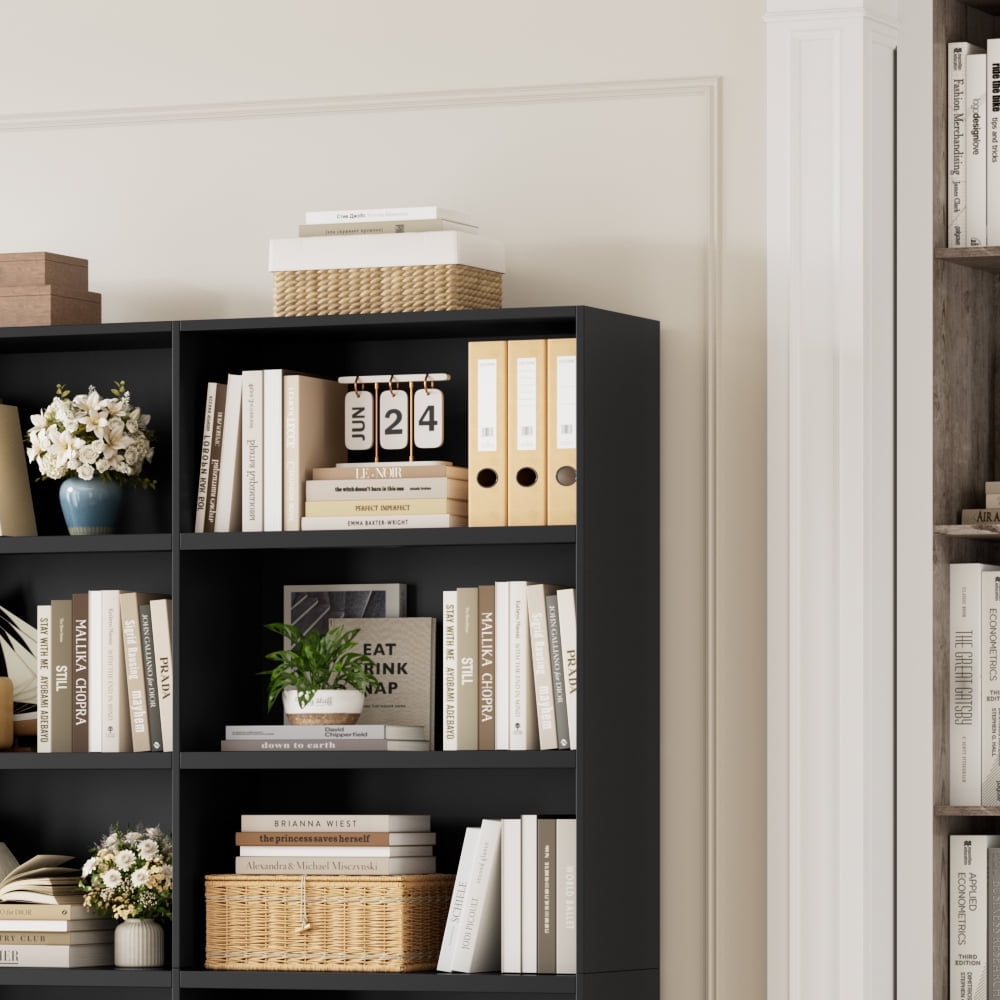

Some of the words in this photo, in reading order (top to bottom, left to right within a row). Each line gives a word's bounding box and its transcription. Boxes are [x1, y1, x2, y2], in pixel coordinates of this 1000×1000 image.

[992, 63, 1000, 78] ride
[954, 79, 964, 110] Fashion
[992, 81, 1000, 93] the
[992, 95, 1000, 112] bike
[990, 118, 998, 129] tips
[951, 114, 964, 175] Merchandising
[952, 181, 960, 196] James
[953, 198, 961, 212] Clark
[352, 406, 365, 440] JUN
[384, 409, 403, 434] 2
[418, 406, 438, 431] 4
[356, 467, 369, 478] LE
[977, 511, 992, 521] AIR
[142, 614, 150, 635] JOHN
[532, 613, 544, 638] Sigrid
[549, 606, 557, 628] JOHN
[75, 620, 86, 672] MALLIKA
[124, 620, 137, 644] Sigrid
[481, 612, 492, 666] MALLIKA
[955, 630, 973, 649] THE
[989, 608, 998, 681] ECONOMETRICS
[40, 638, 48, 656] WITH
[145, 637, 153, 676] GALLIANO
[364, 643, 396, 656] EAT
[447, 649, 454, 660] ME
[550, 629, 560, 670] GALLIANO
[40, 659, 48, 669] ME
[56, 665, 68, 692] STILL
[128, 648, 139, 680] Rausing
[159, 657, 171, 700] PRADA
[461, 657, 473, 685] STILL
[567, 650, 576, 694] PRADA
[955, 651, 973, 684] GREAT
[40, 676, 48, 708] AYOBAMI
[76, 678, 86, 725] CHOPRA
[482, 673, 492, 722] CHOPRA
[954, 687, 973, 725] GATSBY
[131, 690, 145, 733] mayhem
[447, 705, 455, 739] ADEBAYO
[538, 686, 552, 730] mayhem
[40, 710, 48, 743] ADEBAYO
[261, 741, 289, 749] down
[308, 741, 336, 749] earth
[276, 835, 313, 844] princess
[339, 834, 370, 843] herself
[247, 862, 287, 870] Alexandra
[297, 862, 329, 870] Michael
[333, 862, 378, 871] Misczynski
[969, 873, 977, 911] APPLIED
[958, 872, 966, 945] ECONOMETRICS
